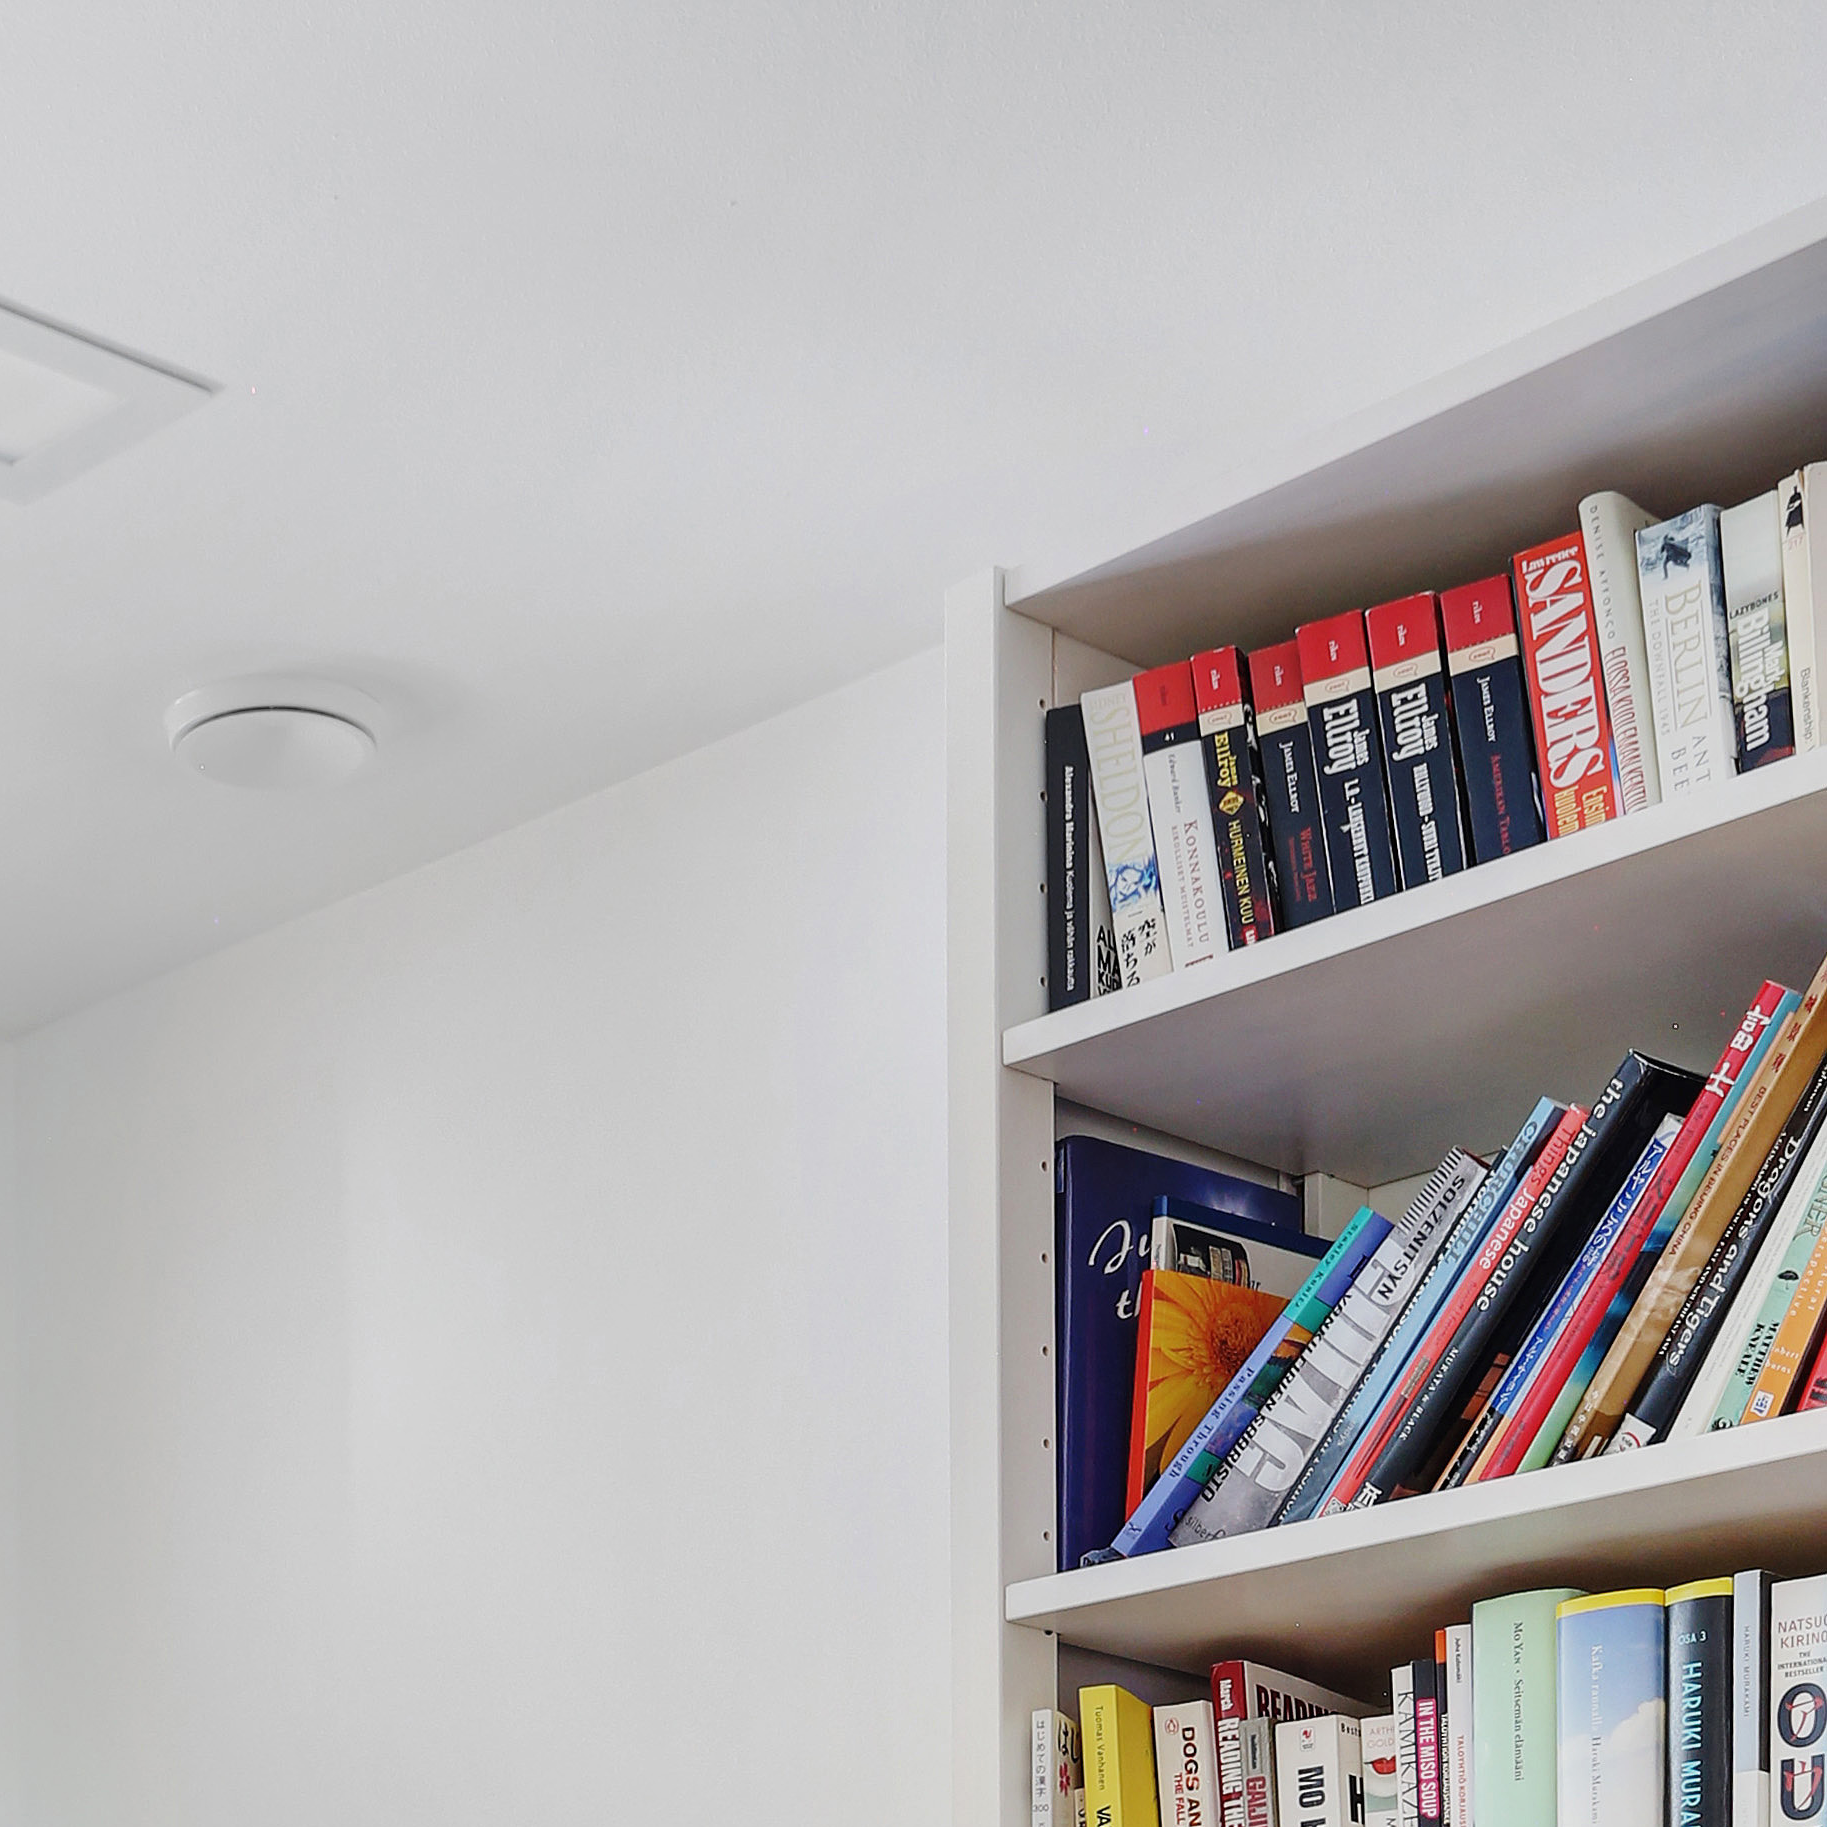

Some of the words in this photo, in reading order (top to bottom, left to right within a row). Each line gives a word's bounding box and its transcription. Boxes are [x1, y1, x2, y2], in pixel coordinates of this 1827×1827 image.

[1521, 546, 1580, 574] Lawrence
[1589, 504, 1605, 560] DENISE
[1729, 591, 1780, 621] LAZYBONES
[1524, 559, 1606, 789] SANDERS
[1665, 580, 1708, 730] BERLIN
[1735, 606, 1770, 752] Billingham
[1764, 639, 1785, 693] Mark
[1323, 698, 1361, 775] Ellroy
[1353, 728, 1371, 766] James
[1391, 683, 1429, 762] Ellroy
[1422, 713, 1440, 752] James
[1090, 706, 1146, 863] SHELDON
[1214, 731, 1233, 787] Ellroy
[1183, 819, 1210, 944] KONNAKOULU
[1228, 820, 1250, 901] HURMEINEN
[1238, 901, 1254, 924] KUU
[1592, 1077, 1625, 1120] the
[1525, 1120, 1597, 1234] japanese
[1530, 1126, 1576, 1188] Things
[1738, 1136, 1801, 1240] Dragons
[1478, 1186, 1530, 1270] Japanese
[1476, 1240, 1531, 1313] house
[1702, 1246, 1749, 1315] and
[1667, 1276, 1726, 1370] Tigers
[1734, 1322, 1767, 1375] KNEALE
[1745, 1318, 1780, 1386] MATTHEW
[1213, 1364, 1257, 1421] Passing
[1167, 1420, 1215, 1480] Through
[1419, 1700, 1435, 1714] IN
[1420, 1716, 1434, 1743] THE
[1681, 1661, 1702, 1751] HARUKI
[1174, 1772, 1184, 1796] THE
[1182, 1726, 1202, 1792] DOGS
[1219, 1717, 1241, 1795] READING
[1298, 1765, 1326, 1808] MO
[1421, 1745, 1436, 1779] MISO
[1176, 1797, 1187, 1826] FALL
[1422, 1781, 1438, 1818] SOUP
